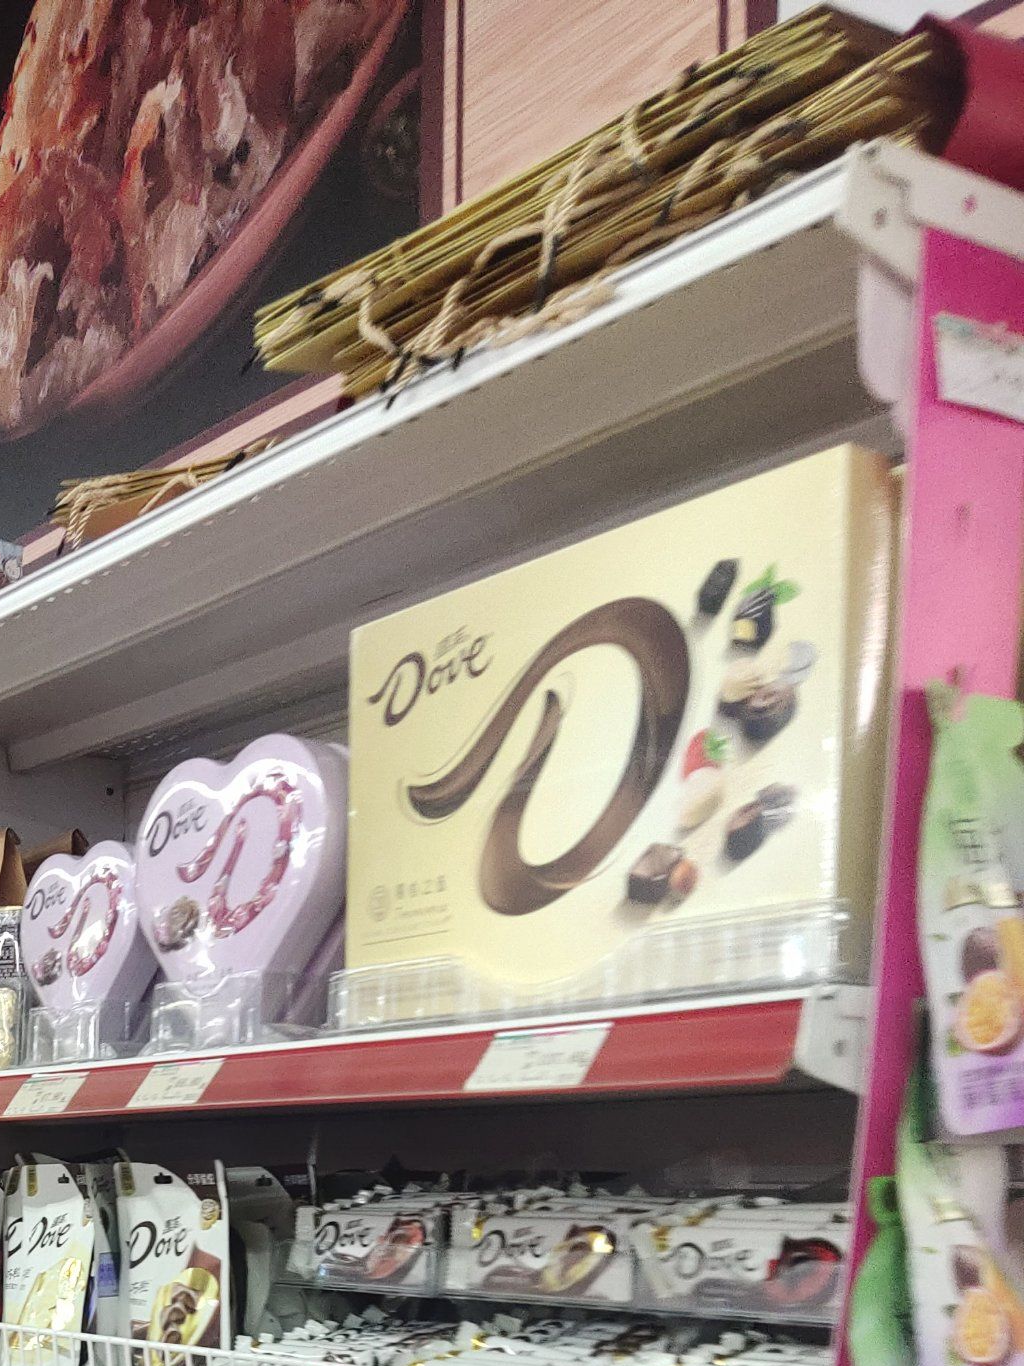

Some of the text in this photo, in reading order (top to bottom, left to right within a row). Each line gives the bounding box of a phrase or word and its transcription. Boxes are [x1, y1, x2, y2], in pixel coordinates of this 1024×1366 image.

[370, 635, 493, 726] Dove
[145, 802, 209, 857] Dove
[26, 884, 67, 920] Dove
[29, 1216, 72, 1255] Dove
[126, 1221, 191, 1269] Dove
[314, 1219, 373, 1254] Dove
